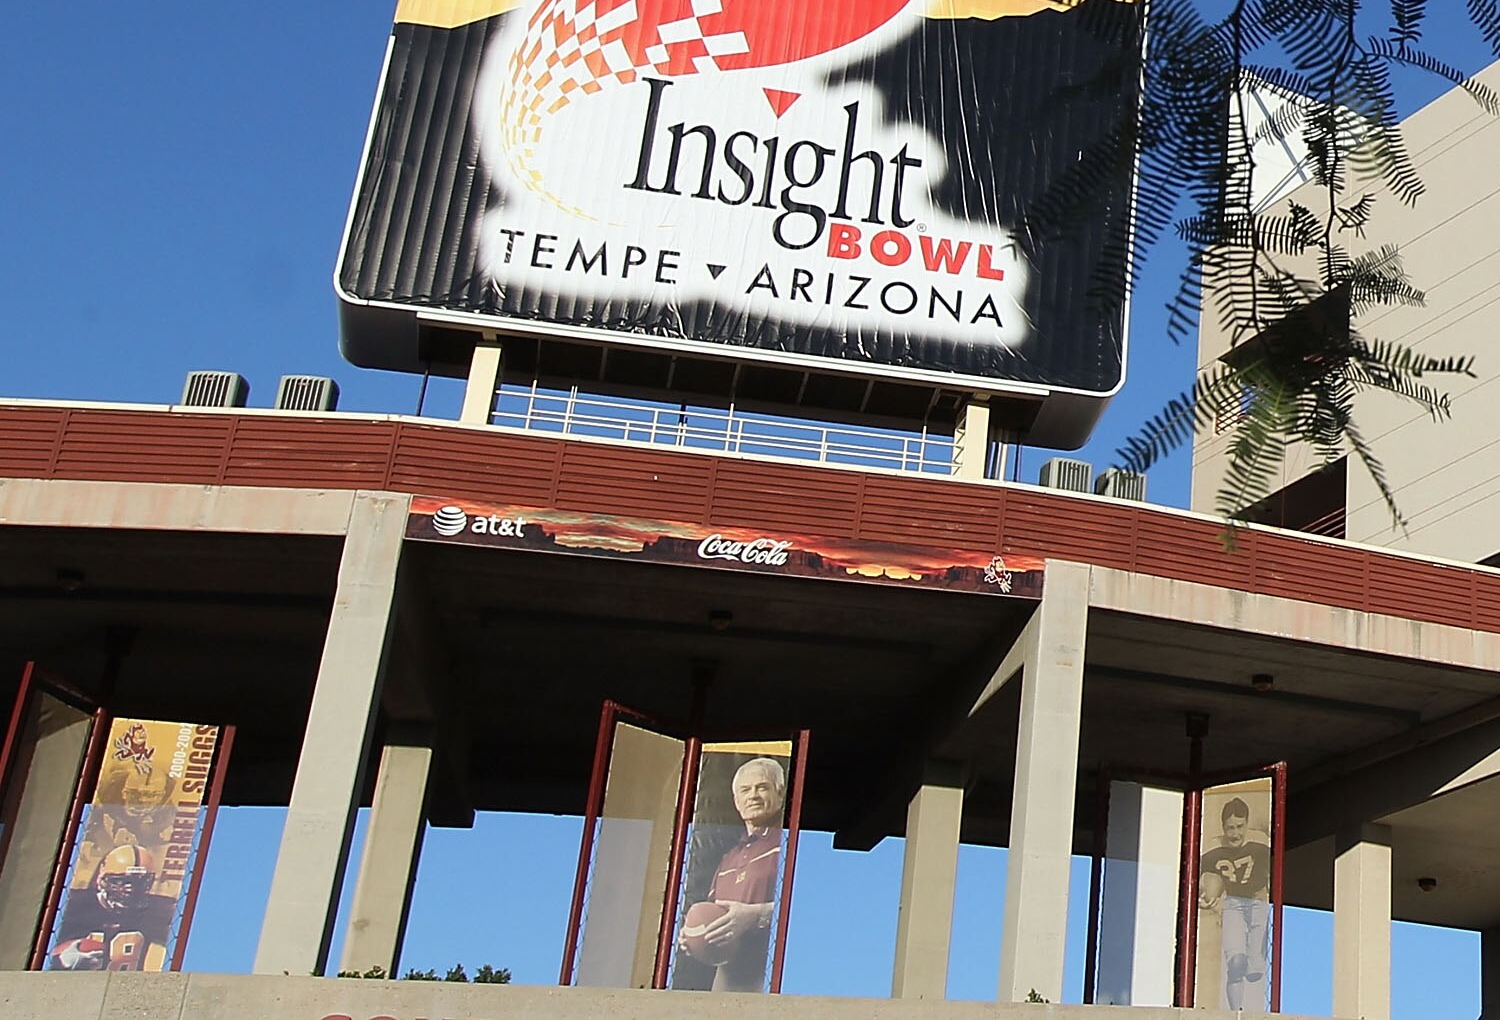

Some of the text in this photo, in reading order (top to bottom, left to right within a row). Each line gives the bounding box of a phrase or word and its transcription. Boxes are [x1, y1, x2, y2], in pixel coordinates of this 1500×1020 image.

[624, 78, 923, 250] Insight
[500, 229, 1004, 328] TEMPE ARIZONA
[827, 223, 1004, 281] BOWL
[471, 514, 527, 538] at&t
[697, 533, 793, 566] Coca-Cola
[160, 724, 217, 884] TERRELL SUGGS
